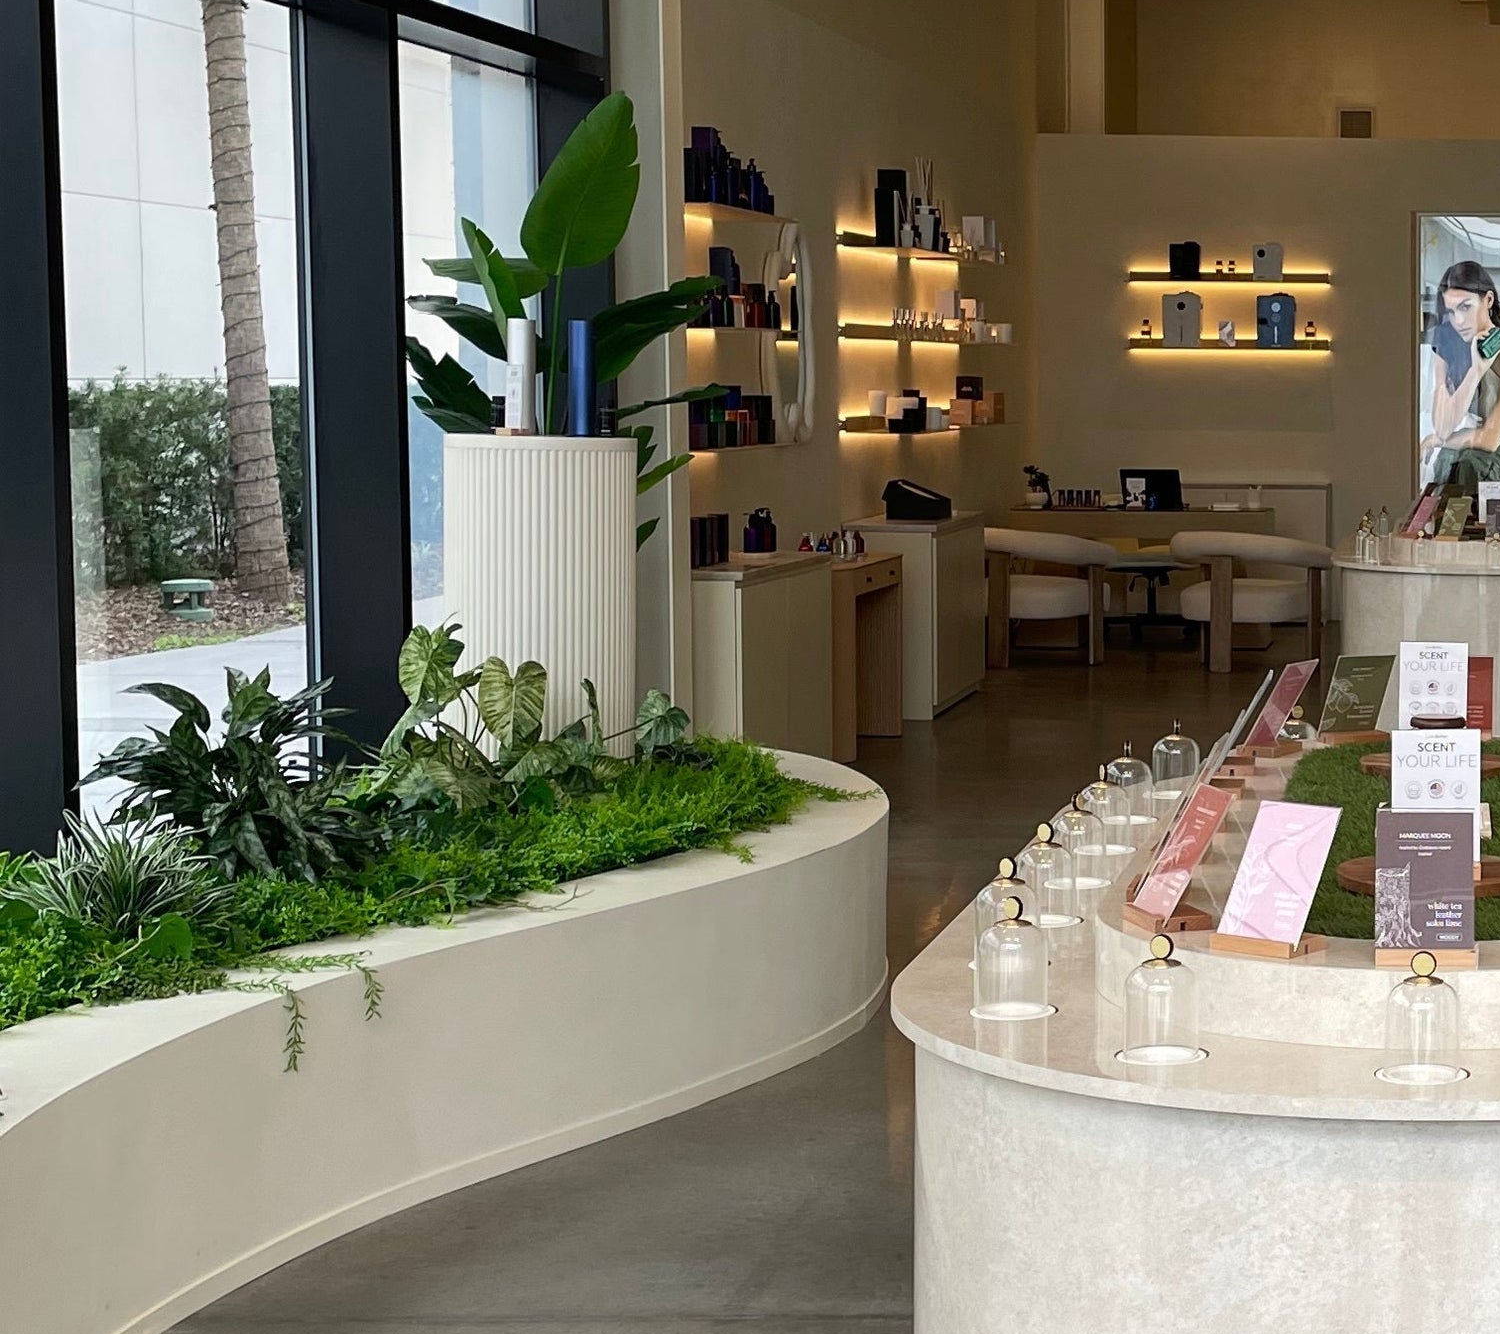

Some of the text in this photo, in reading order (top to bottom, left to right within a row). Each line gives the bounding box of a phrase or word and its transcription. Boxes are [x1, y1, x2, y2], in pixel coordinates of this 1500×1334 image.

[1419, 651, 1448, 660] SCENT
[1403, 661, 1464, 672] YOUR LIFE
[1417, 742, 1456, 753] SCENT
[1397, 754, 1478, 768] YOUR LIFE
[1427, 901, 1449, 910] white
